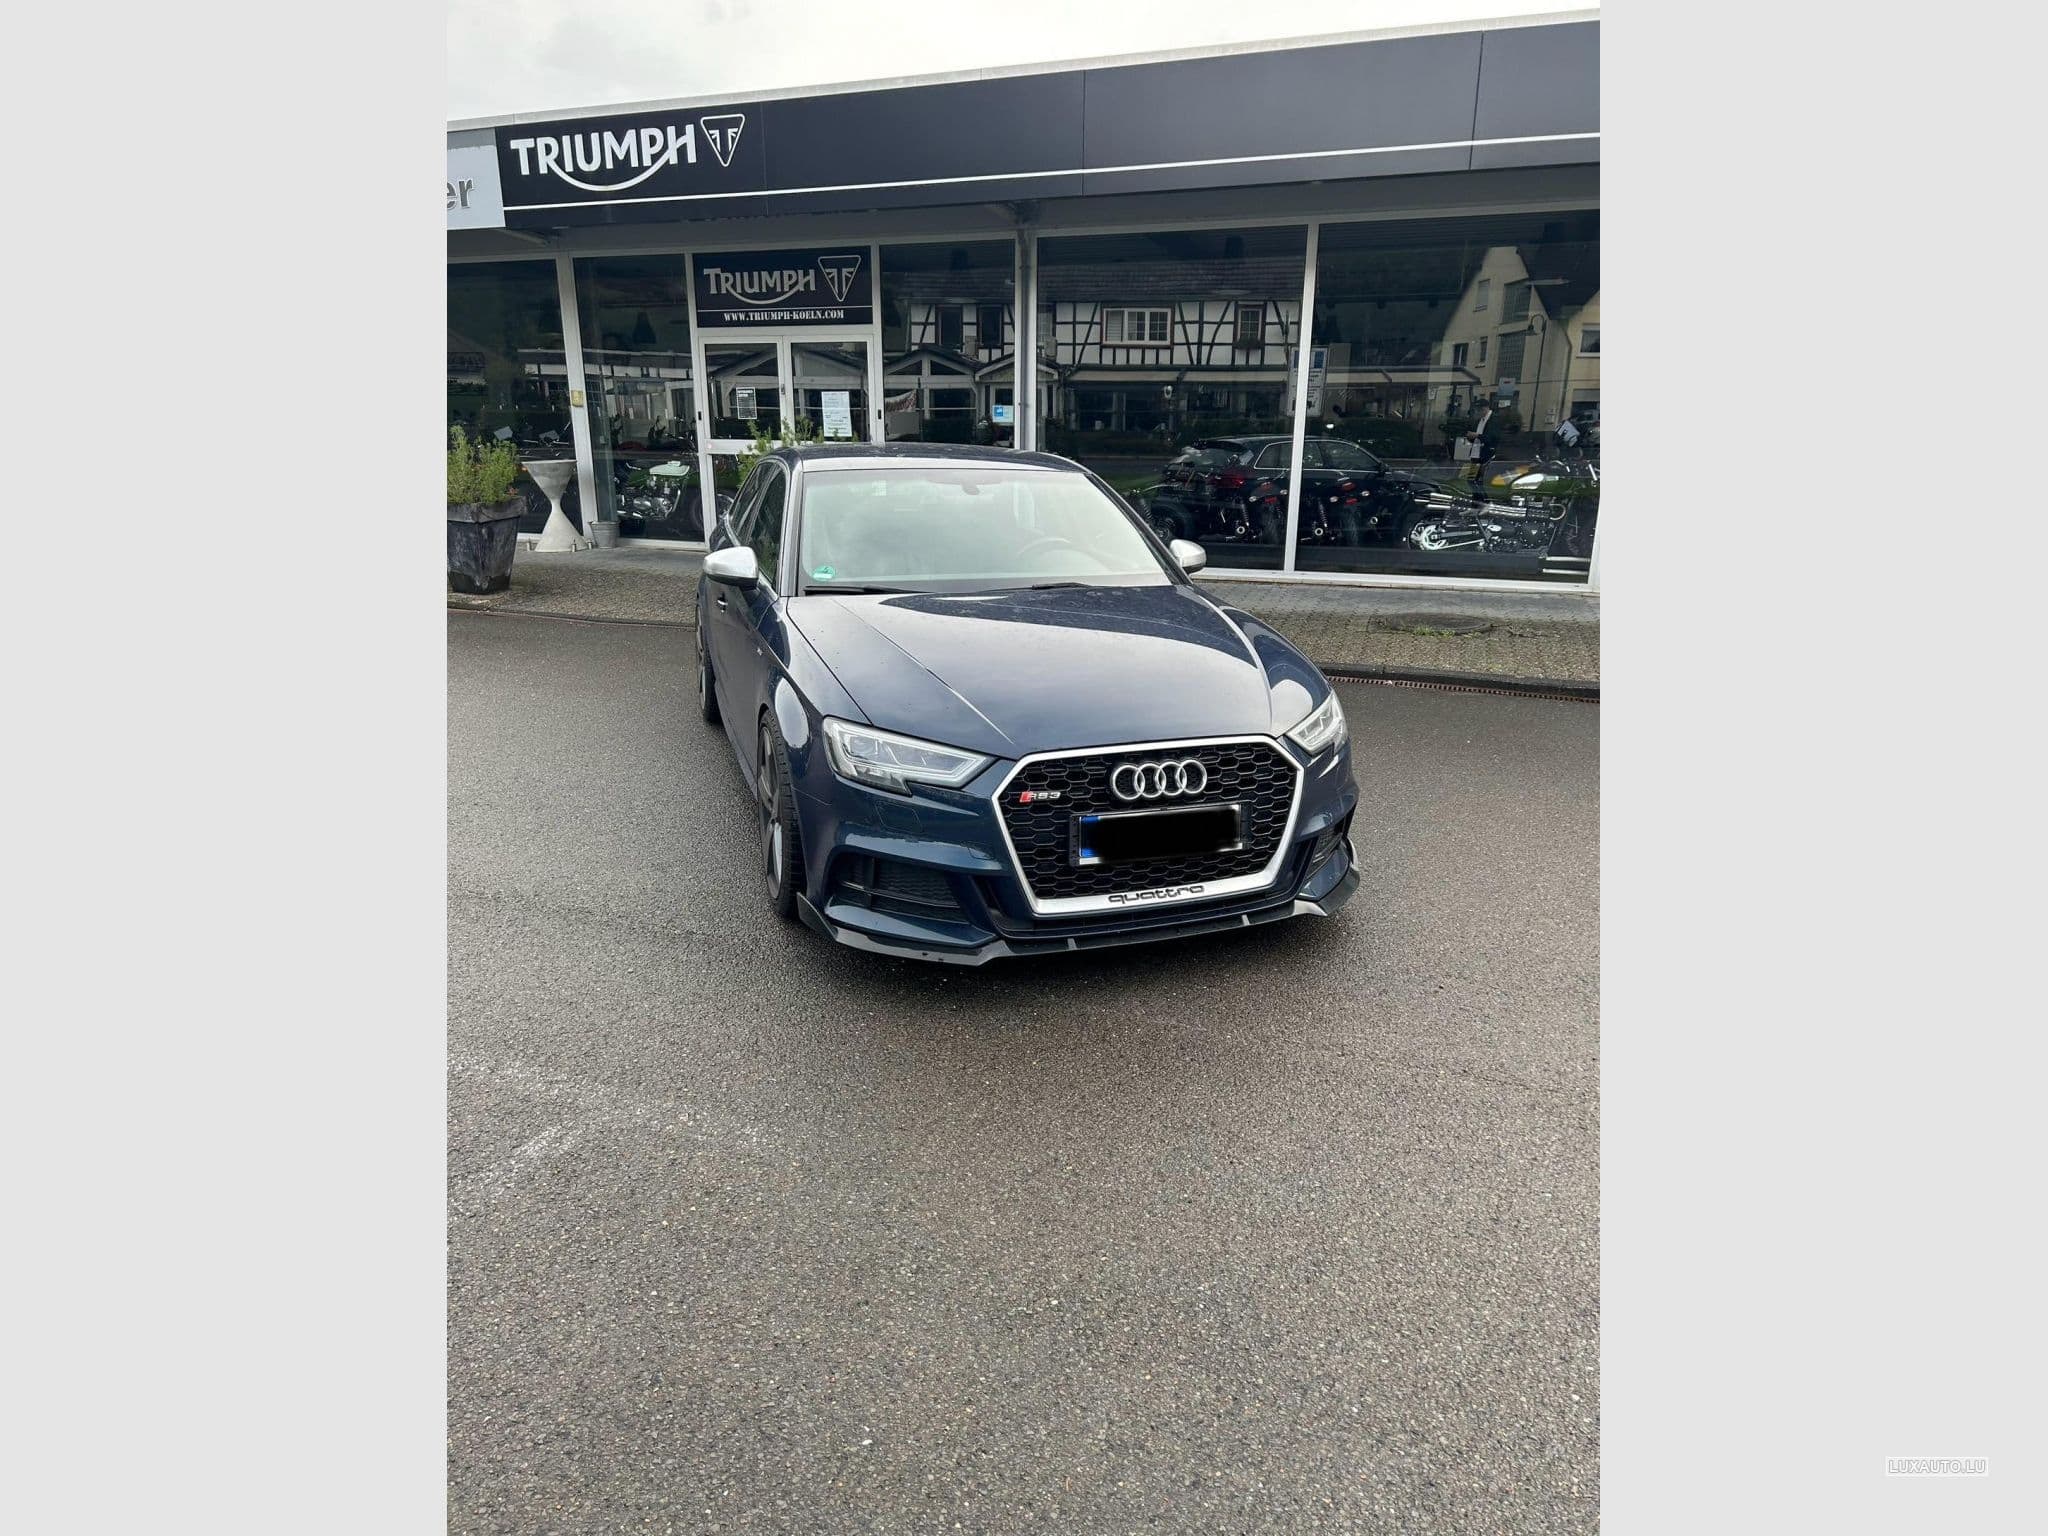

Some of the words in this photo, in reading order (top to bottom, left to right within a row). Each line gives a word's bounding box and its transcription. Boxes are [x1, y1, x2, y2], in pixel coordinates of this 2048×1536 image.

[510, 124, 697, 191] TRIUMPH
[703, 268, 816, 304] TRIUMPH
[724, 310, 844, 321] WWW.TRIUMPH-KOELN.COM
[1108, 885, 1204, 904] quattro
